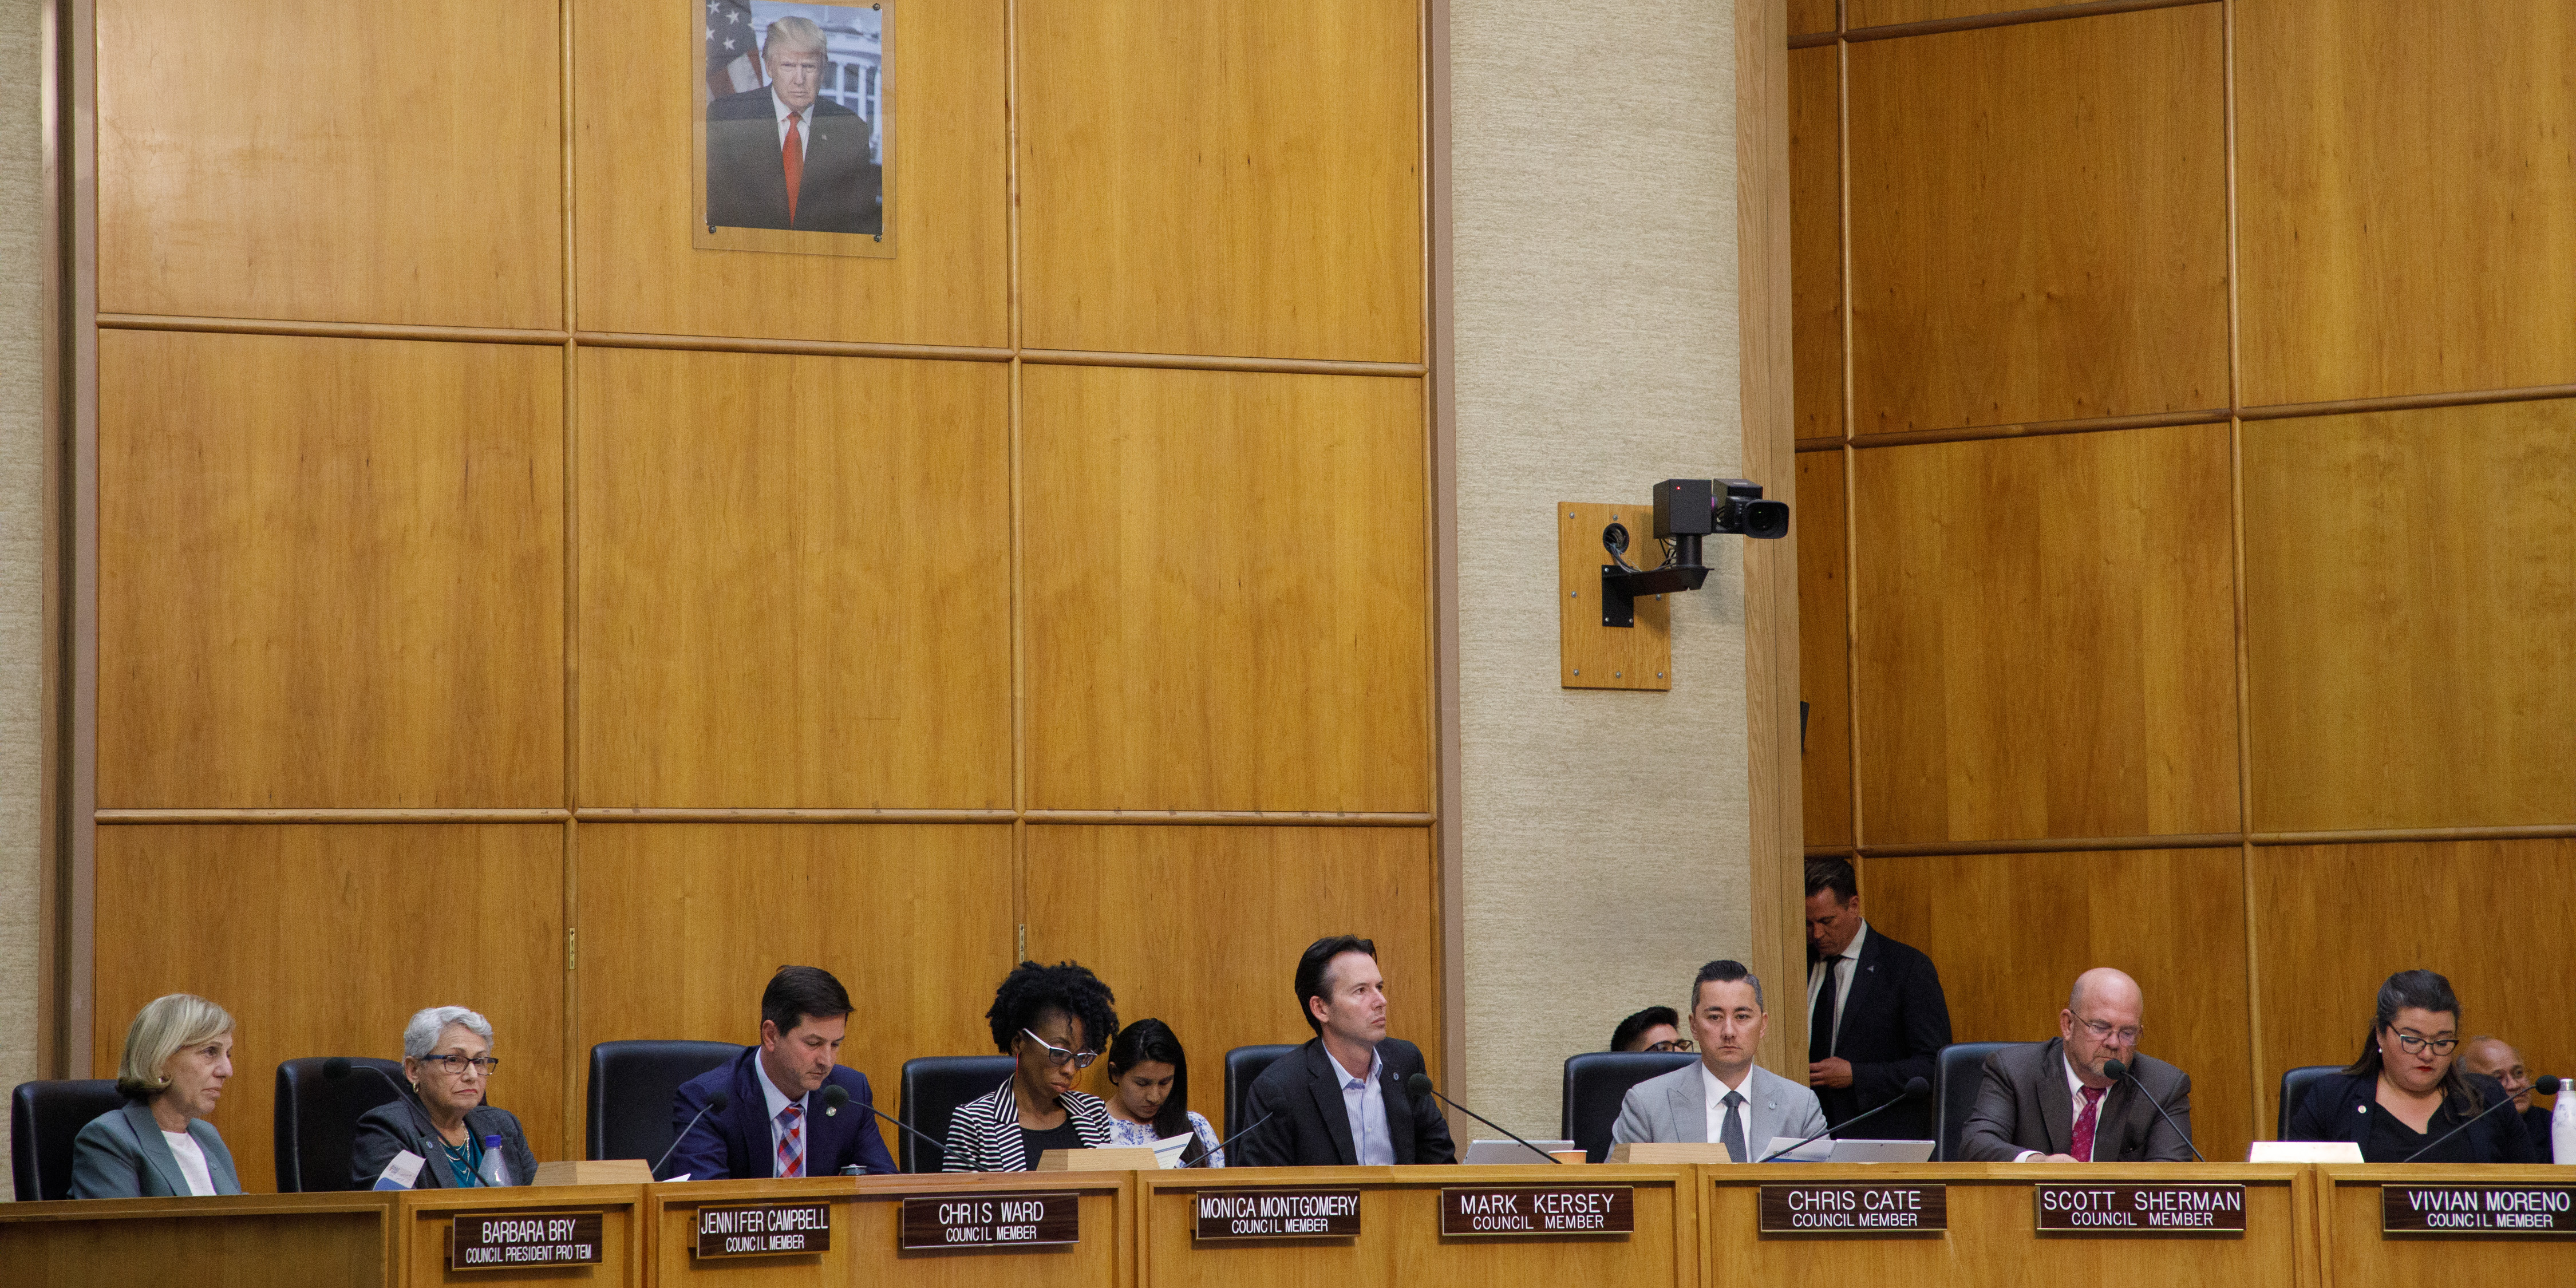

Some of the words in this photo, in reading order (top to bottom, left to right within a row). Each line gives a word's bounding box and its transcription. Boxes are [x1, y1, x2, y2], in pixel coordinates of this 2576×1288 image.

[1200, 1197, 1257, 1219] MONICA
[1261, 1196, 1358, 1217] MONTGOMERY
[1461, 1195, 1518, 1214] MARK
[1534, 1194, 1614, 1214] KERSEY
[1788, 1191, 1856, 1211] CHRIS
[1864, 1190, 1922, 1210] CATE
[2044, 1191, 2116, 1210] SCOTT
[2135, 1191, 2240, 1211] SHERMAN
[2408, 1191, 2478, 1211] VIVIAN
[2486, 1191, 2570, 1211] MORENO
[701, 1211, 764, 1234] JENNIFER
[768, 1208, 828, 1231] CAMPBELL
[939, 1202, 993, 1224] CHRIS
[1001, 1201, 1044, 1223] WARD
[1792, 1213, 1855, 1227] COUNCIL
[1859, 1213, 1918, 1227] MEMBER
[2072, 1212, 2138, 1226] COUNCIL
[2149, 1212, 2213, 1226] MEMBER
[2427, 1213, 2492, 1227] COUNCIL
[2496, 1214, 2553, 1227] MEMBER
[483, 1220, 545, 1243] BARBARA
[549, 1219, 575, 1241] BRY
[1231, 1219, 1282, 1234] COUNCIL
[1285, 1218, 1328, 1232] MEMBER
[1473, 1215, 1529, 1230] COUNCIL
[1545, 1215, 1604, 1229] MEMBER
[946, 1227, 993, 1242] COUNCIL
[997, 1225, 1037, 1240] MEMBER
[726, 1236, 767, 1253] COUNCIL
[769, 1234, 804, 1250] MEMBER
[466, 1247, 503, 1263] COUNCIL
[505, 1245, 554, 1262] PRESIDENT
[556, 1244, 573, 1260] PRO
[575, 1244, 591, 1259] TEM
